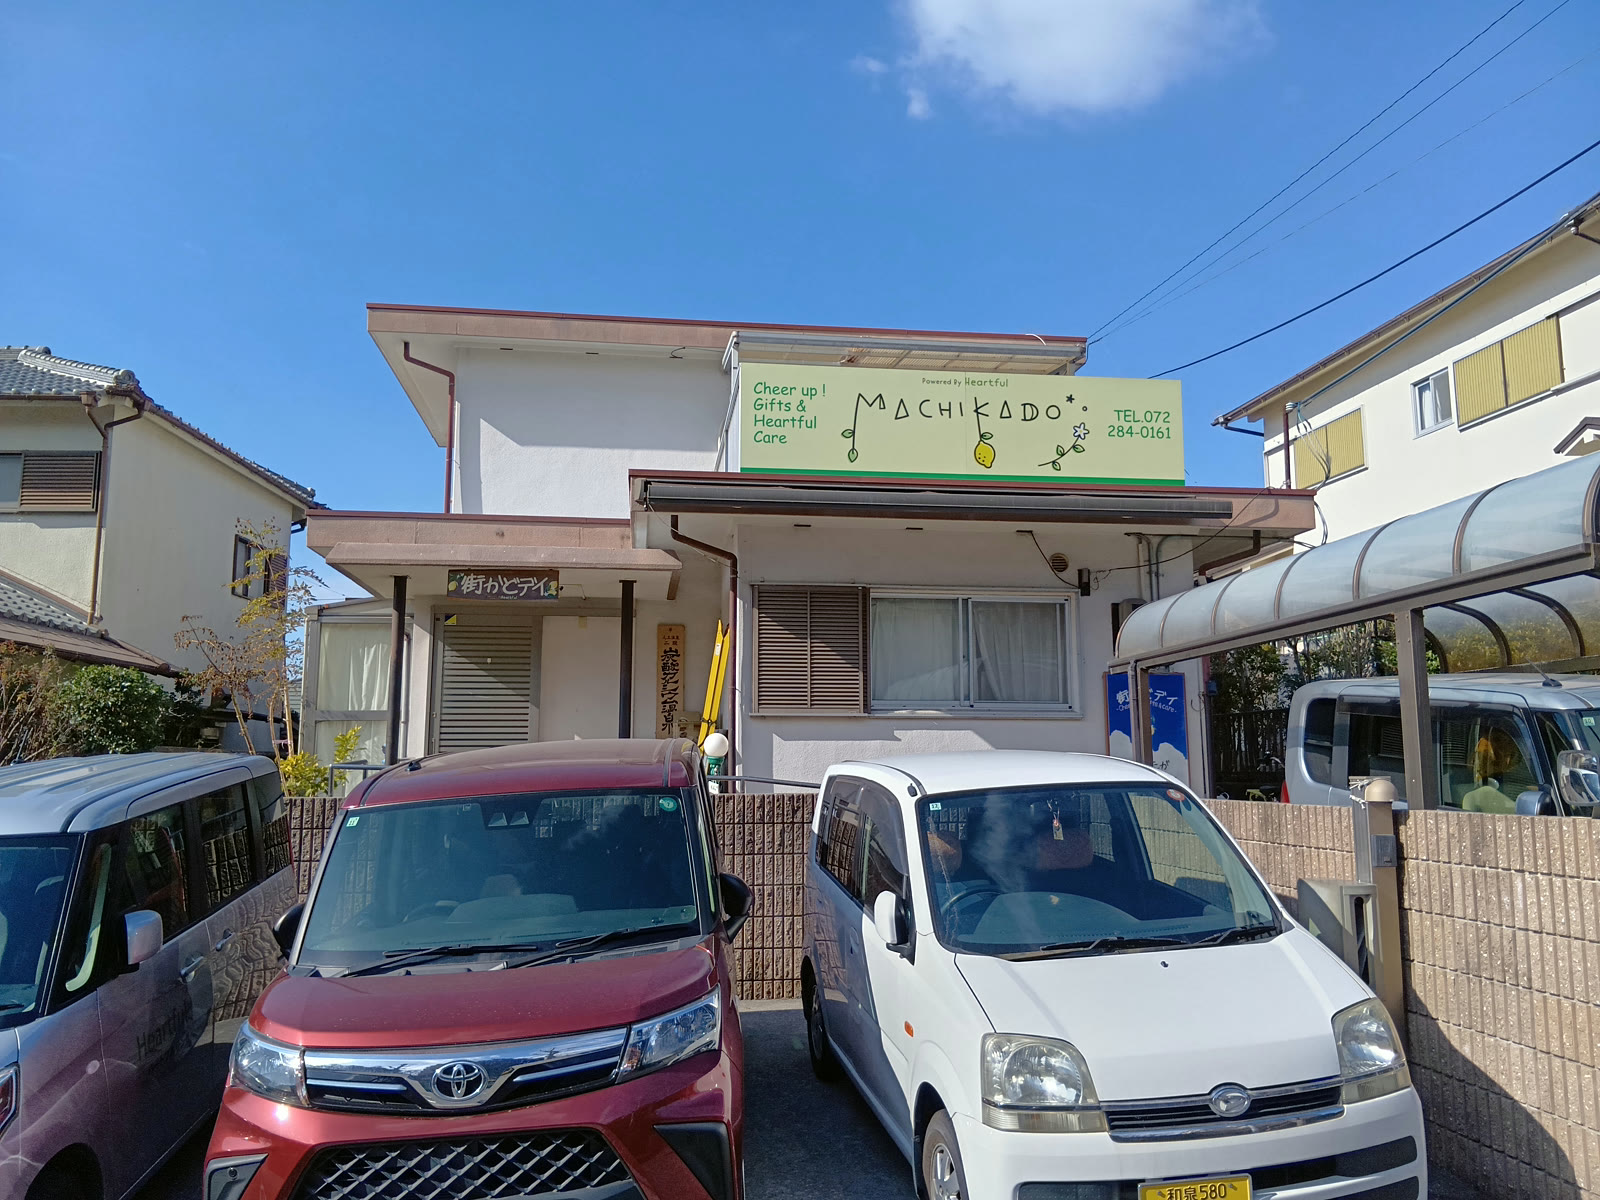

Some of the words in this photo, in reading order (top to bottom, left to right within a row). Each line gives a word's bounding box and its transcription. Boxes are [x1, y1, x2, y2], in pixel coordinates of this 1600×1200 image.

[753, 382, 797, 396] Cheer
[922, 377, 951, 386] Powered
[965, 377, 1009, 387] Heartful
[753, 397, 792, 412] Gifts
[796, 399, 807, 413] &
[753, 414, 817, 429] Heartful
[1113, 409, 1171, 424] TEL.072
[753, 430, 788, 444] Care
[1107, 425, 1171, 440] 284-0161
[461, 573, 549, 597] 街かどデイ
